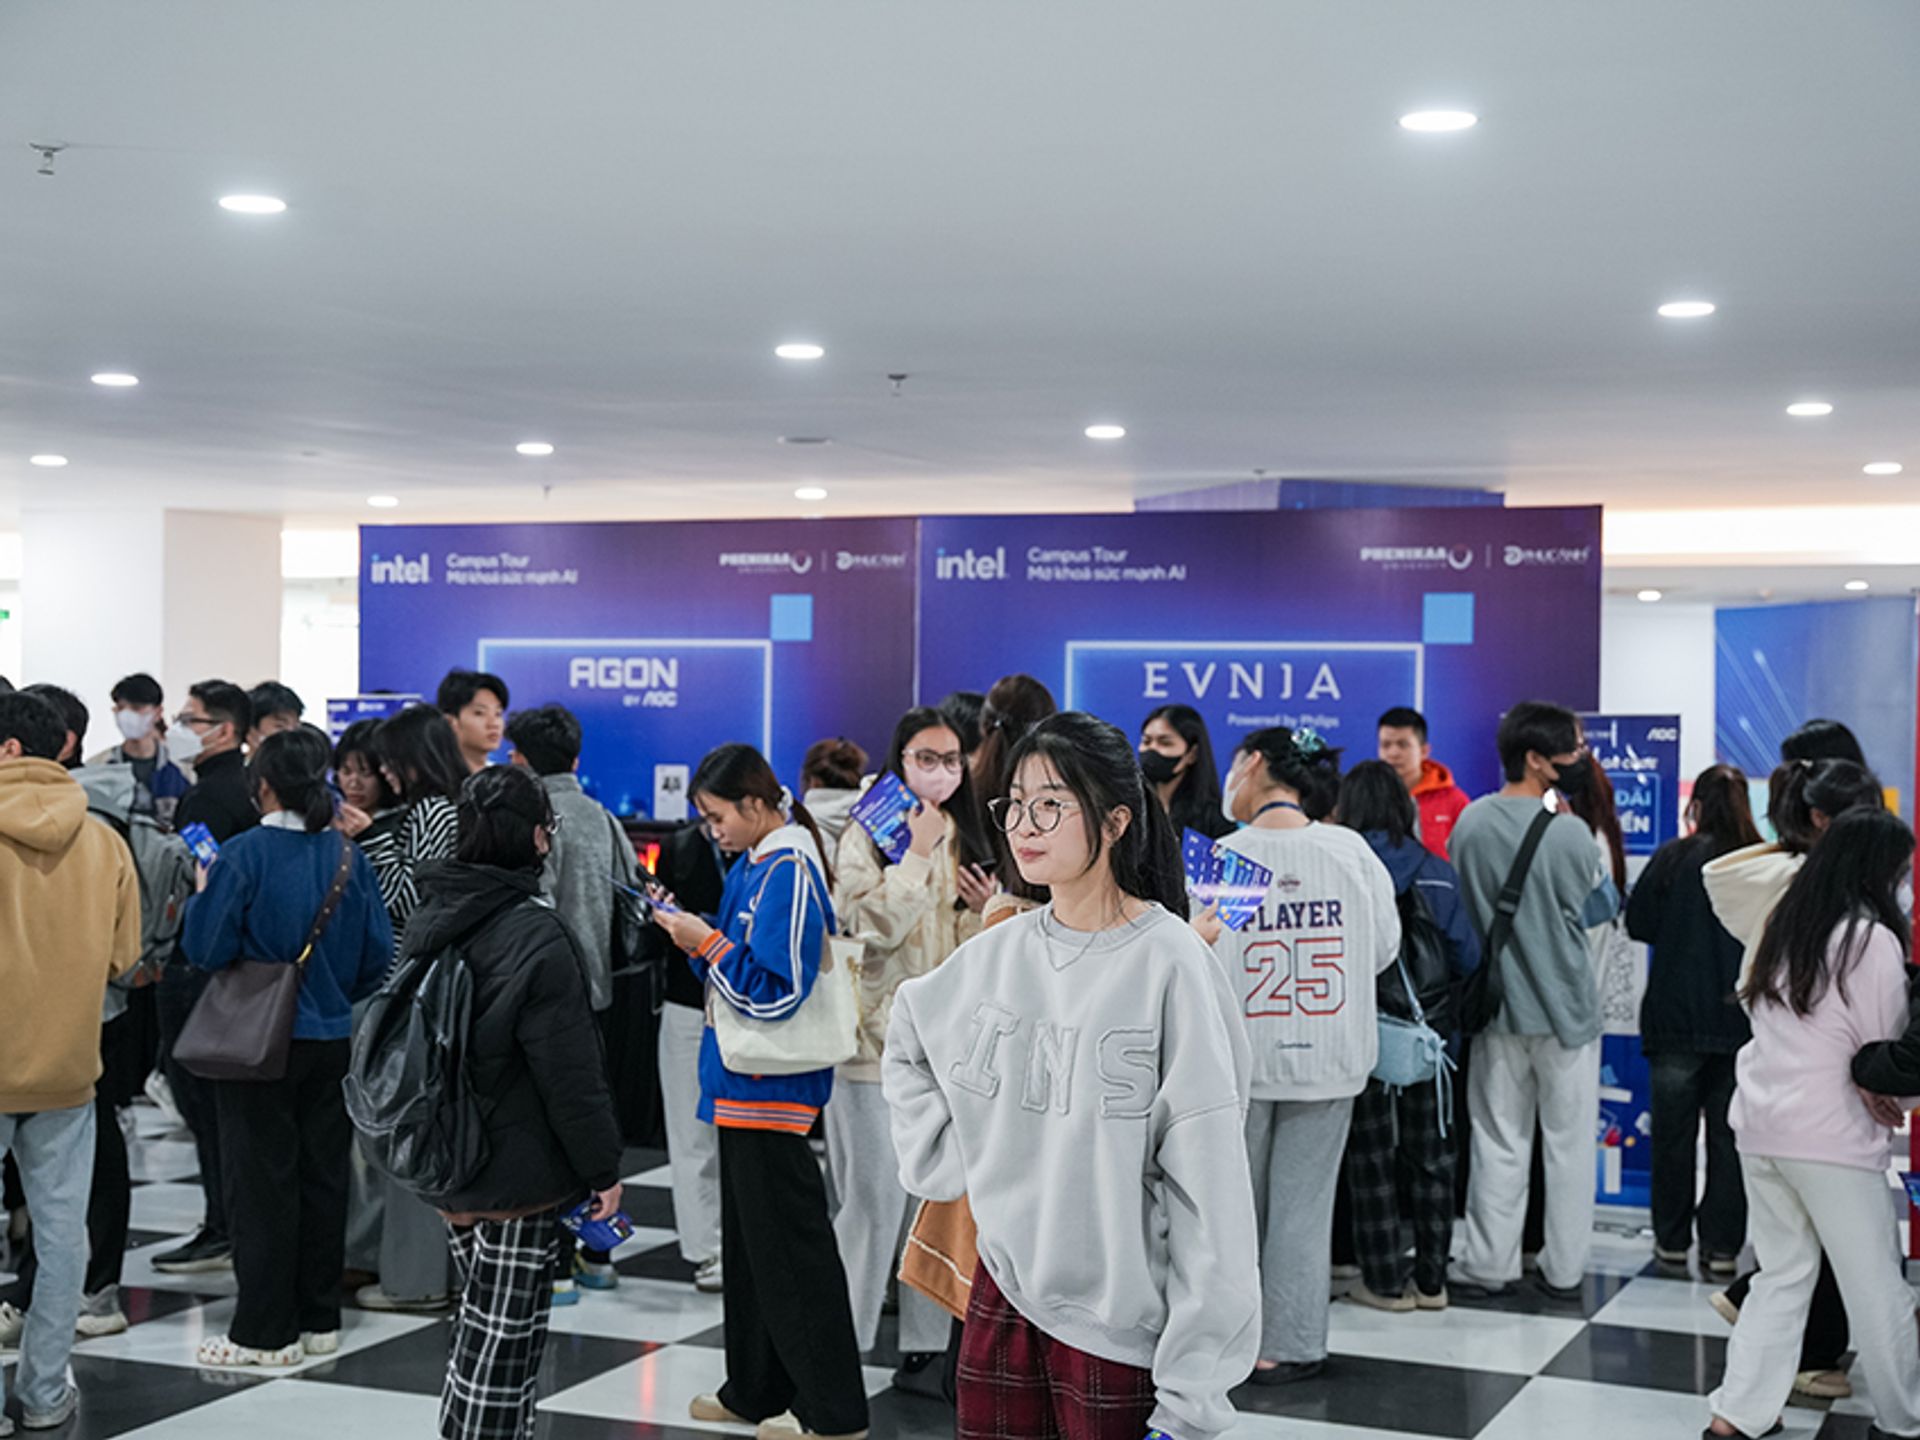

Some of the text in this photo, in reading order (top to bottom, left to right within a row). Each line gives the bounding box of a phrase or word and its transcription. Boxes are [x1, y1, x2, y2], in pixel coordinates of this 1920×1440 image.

[370, 553, 430, 584] intel
[446, 552, 530, 571] Campus Tour
[936, 546, 1006, 580] intel
[1026, 546, 1128, 565] Campus Tour
[1167, 565, 1187, 581] AI
[569, 657, 678, 689] AGON
[1243, 936, 1346, 1019] 25
[949, 1001, 1158, 1120] INS
